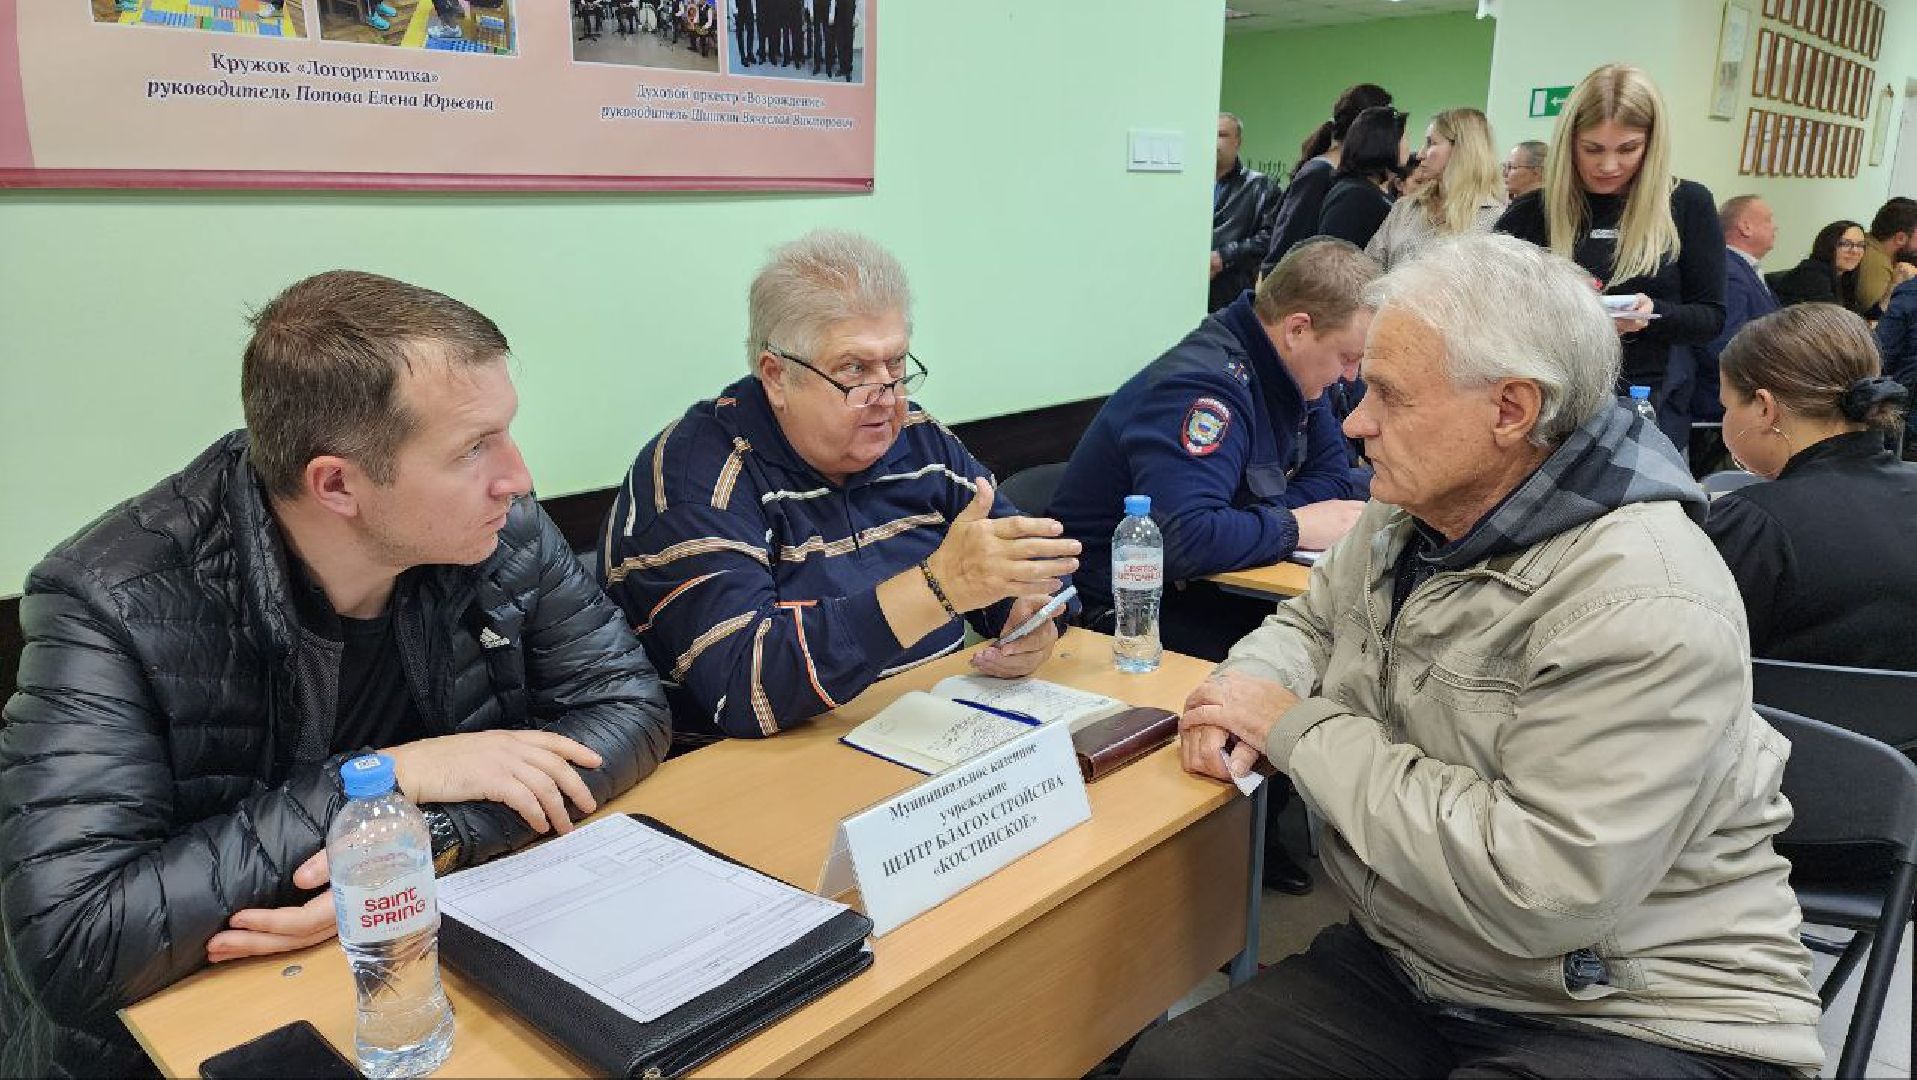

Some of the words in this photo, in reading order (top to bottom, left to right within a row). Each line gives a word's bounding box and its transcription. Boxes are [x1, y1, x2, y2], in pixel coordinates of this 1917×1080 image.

[211, 53, 291, 75] Кружок
[297, 60, 439, 83] «Логоритмика»
[147, 79, 290, 99] руководитель
[296, 85, 363, 103] Попова
[368, 90, 418, 107] Елена
[422, 93, 495, 112] Юрьевна
[637, 84, 690, 101] Духовой
[693, 91, 738, 105] оркестр
[601, 105, 688, 119] руководитель
[888, 765, 988, 821] Муниципальное
[990, 743, 1038, 774] казенное
[939, 780, 1008, 826] учреждение
[881, 839, 932, 877] ЦЕНТР
[936, 773, 1065, 850] БЛАГОУСТРОЙСТВА
[933, 812, 1038, 877] «КОСТИНСКОЕ»
[364, 886, 418, 913] saint
